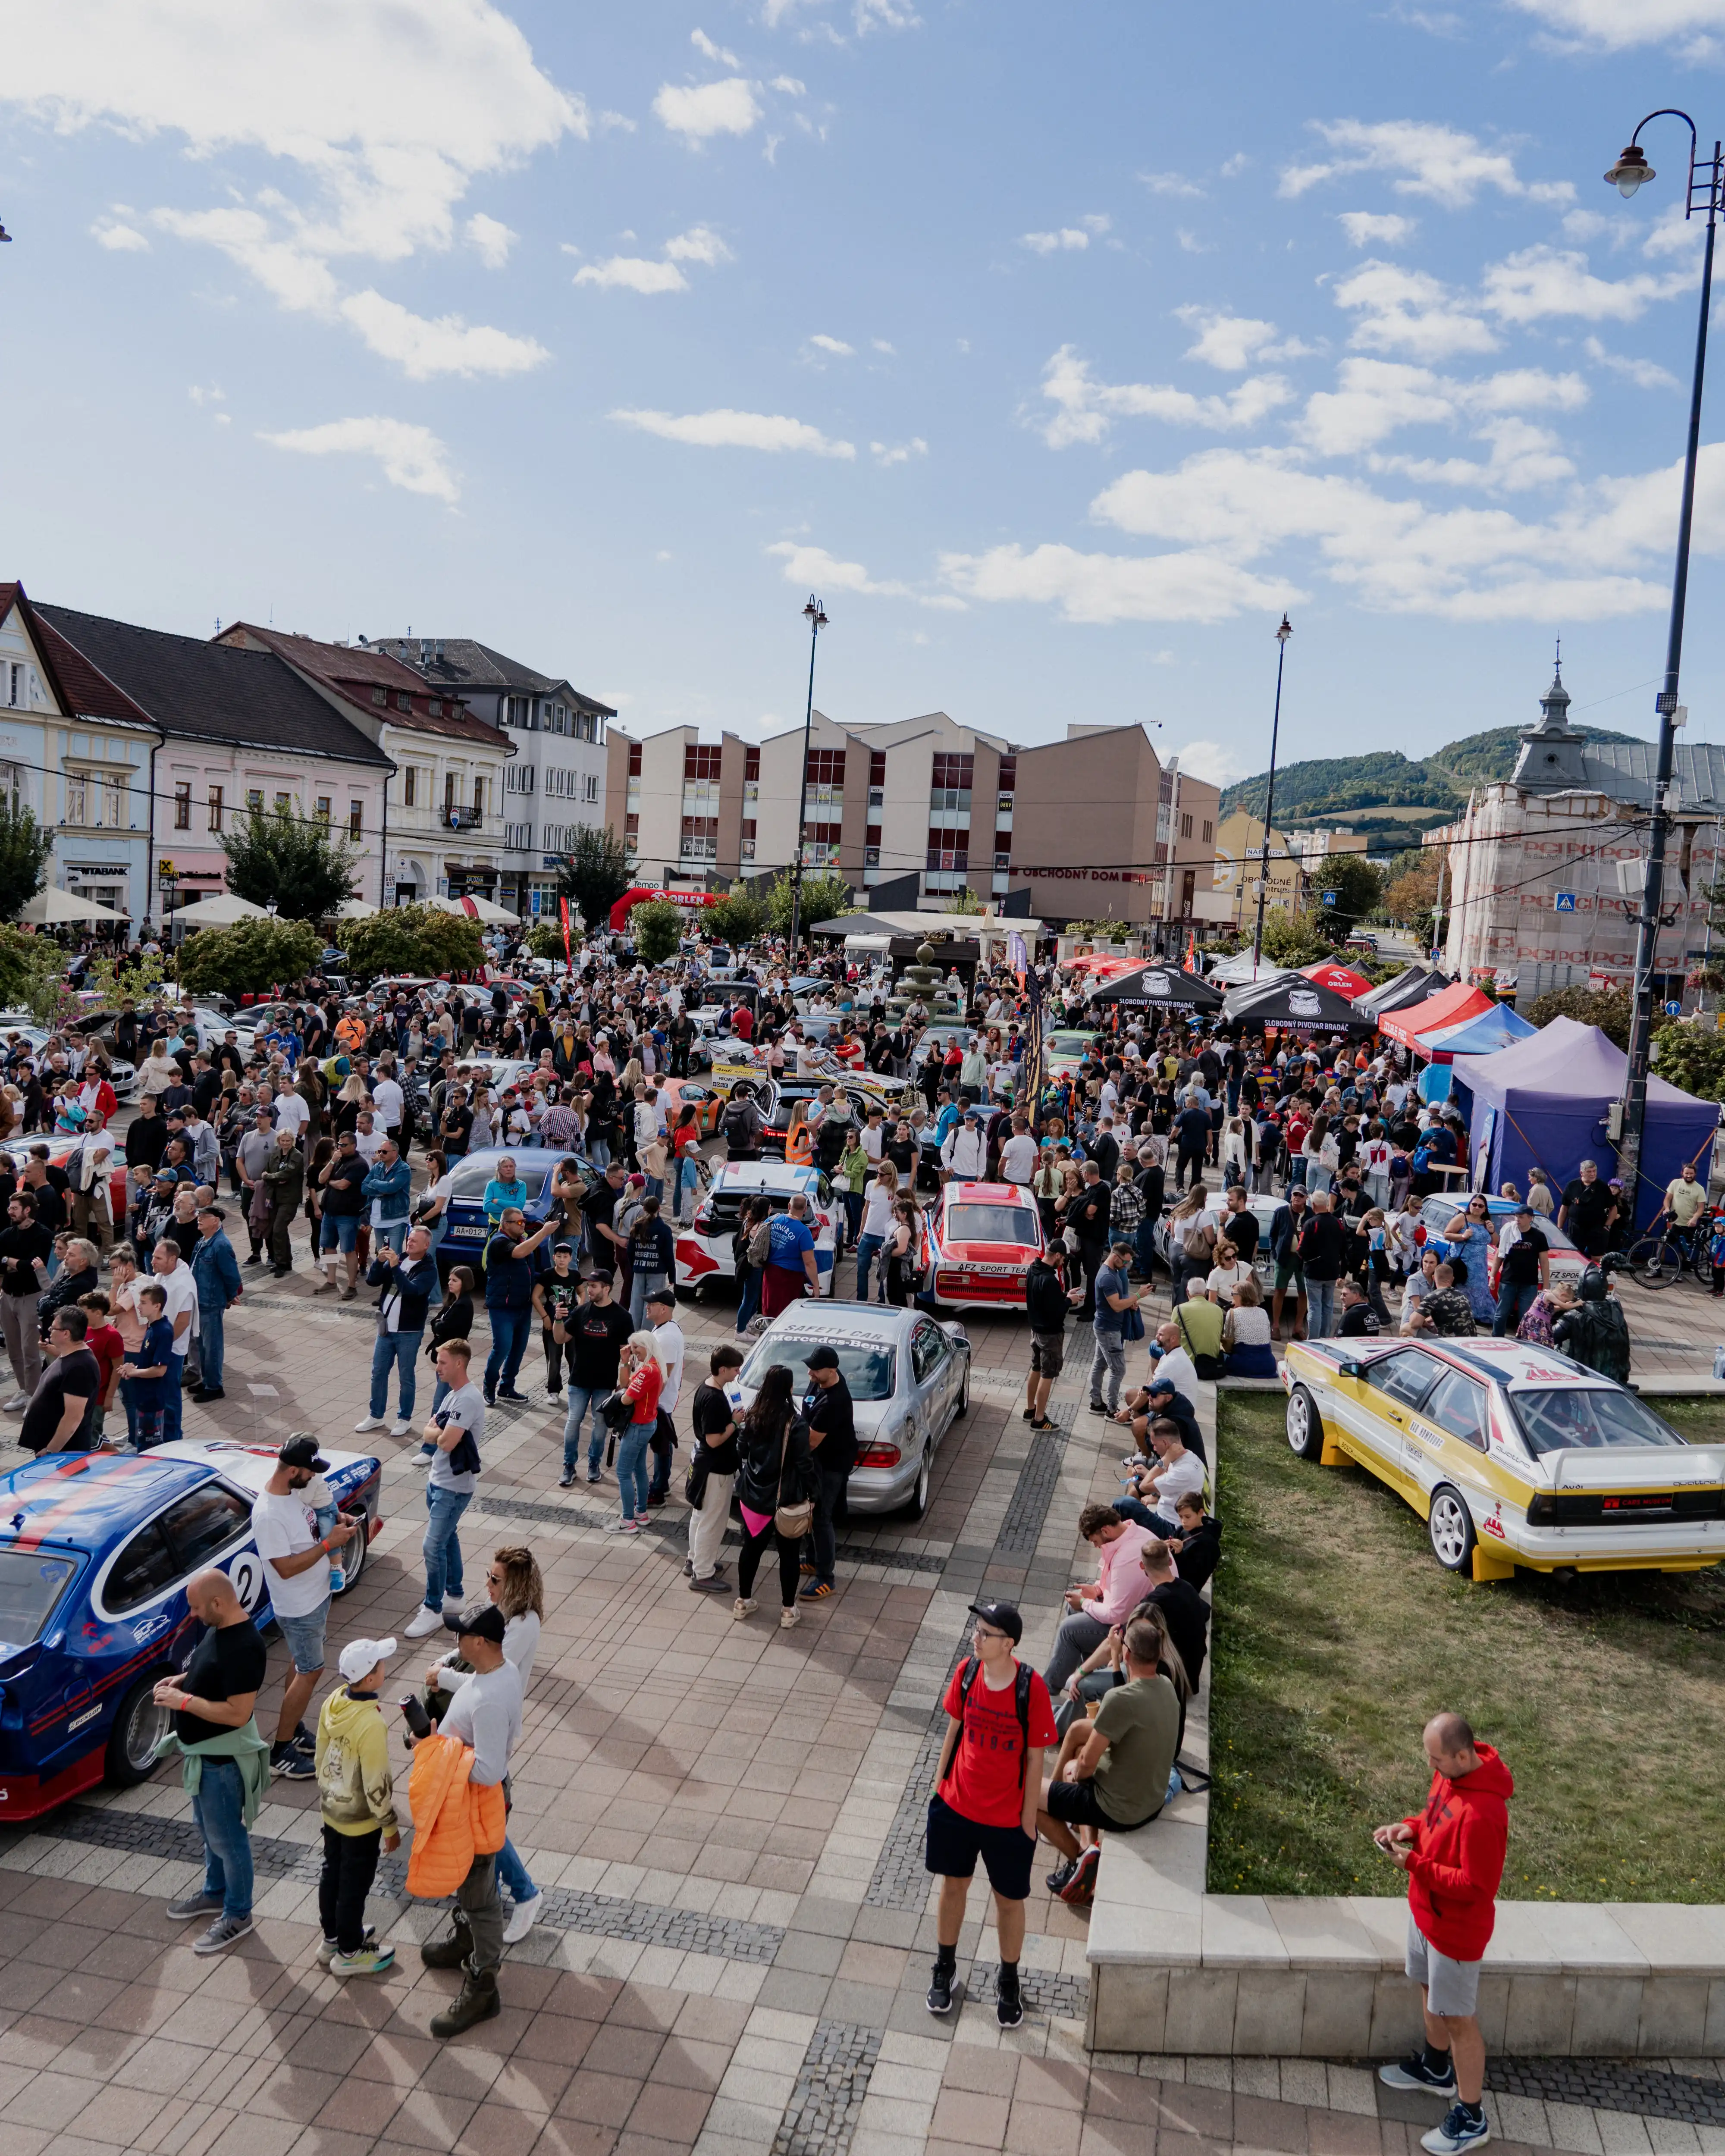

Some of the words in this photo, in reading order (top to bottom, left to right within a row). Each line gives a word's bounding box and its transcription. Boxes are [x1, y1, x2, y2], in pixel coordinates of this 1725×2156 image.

[1524, 841, 1562, 854] PCI
[1092, 871, 1119, 881] DOM
[1241, 876, 1292, 886] OBCODNÉ
[634, 881, 659, 889] Tempo
[669, 894, 704, 905] ORLEN
[1593, 952, 1633, 965] PCI
[1173, 1001, 1195, 1009] BRADÁČ
[1264, 1019, 1296, 1028] SLOBODNÝ
[1297, 1021, 1324, 1030] PIVOVAR
[1325, 1022, 1349, 1032] BRADÁČ
[788, 1232, 795, 1240] CO
[784, 1325, 847, 1334] SAFETY
[850, 1330, 884, 1340] CAR
[768, 1335, 890, 1352] Mercedes-Benz
[1308, 1384, 1324, 1394] MICHELIN
[1410, 1421, 1419, 1433] BAD
[1341, 1440, 1353, 1454] BOSCH
[1495, 1445, 1531, 1469] quattro
[1443, 1474, 1461, 1488] MICHELIN
[1486, 1524, 1503, 1537] garage
[75, 1706, 100, 1725] DUNLOP
